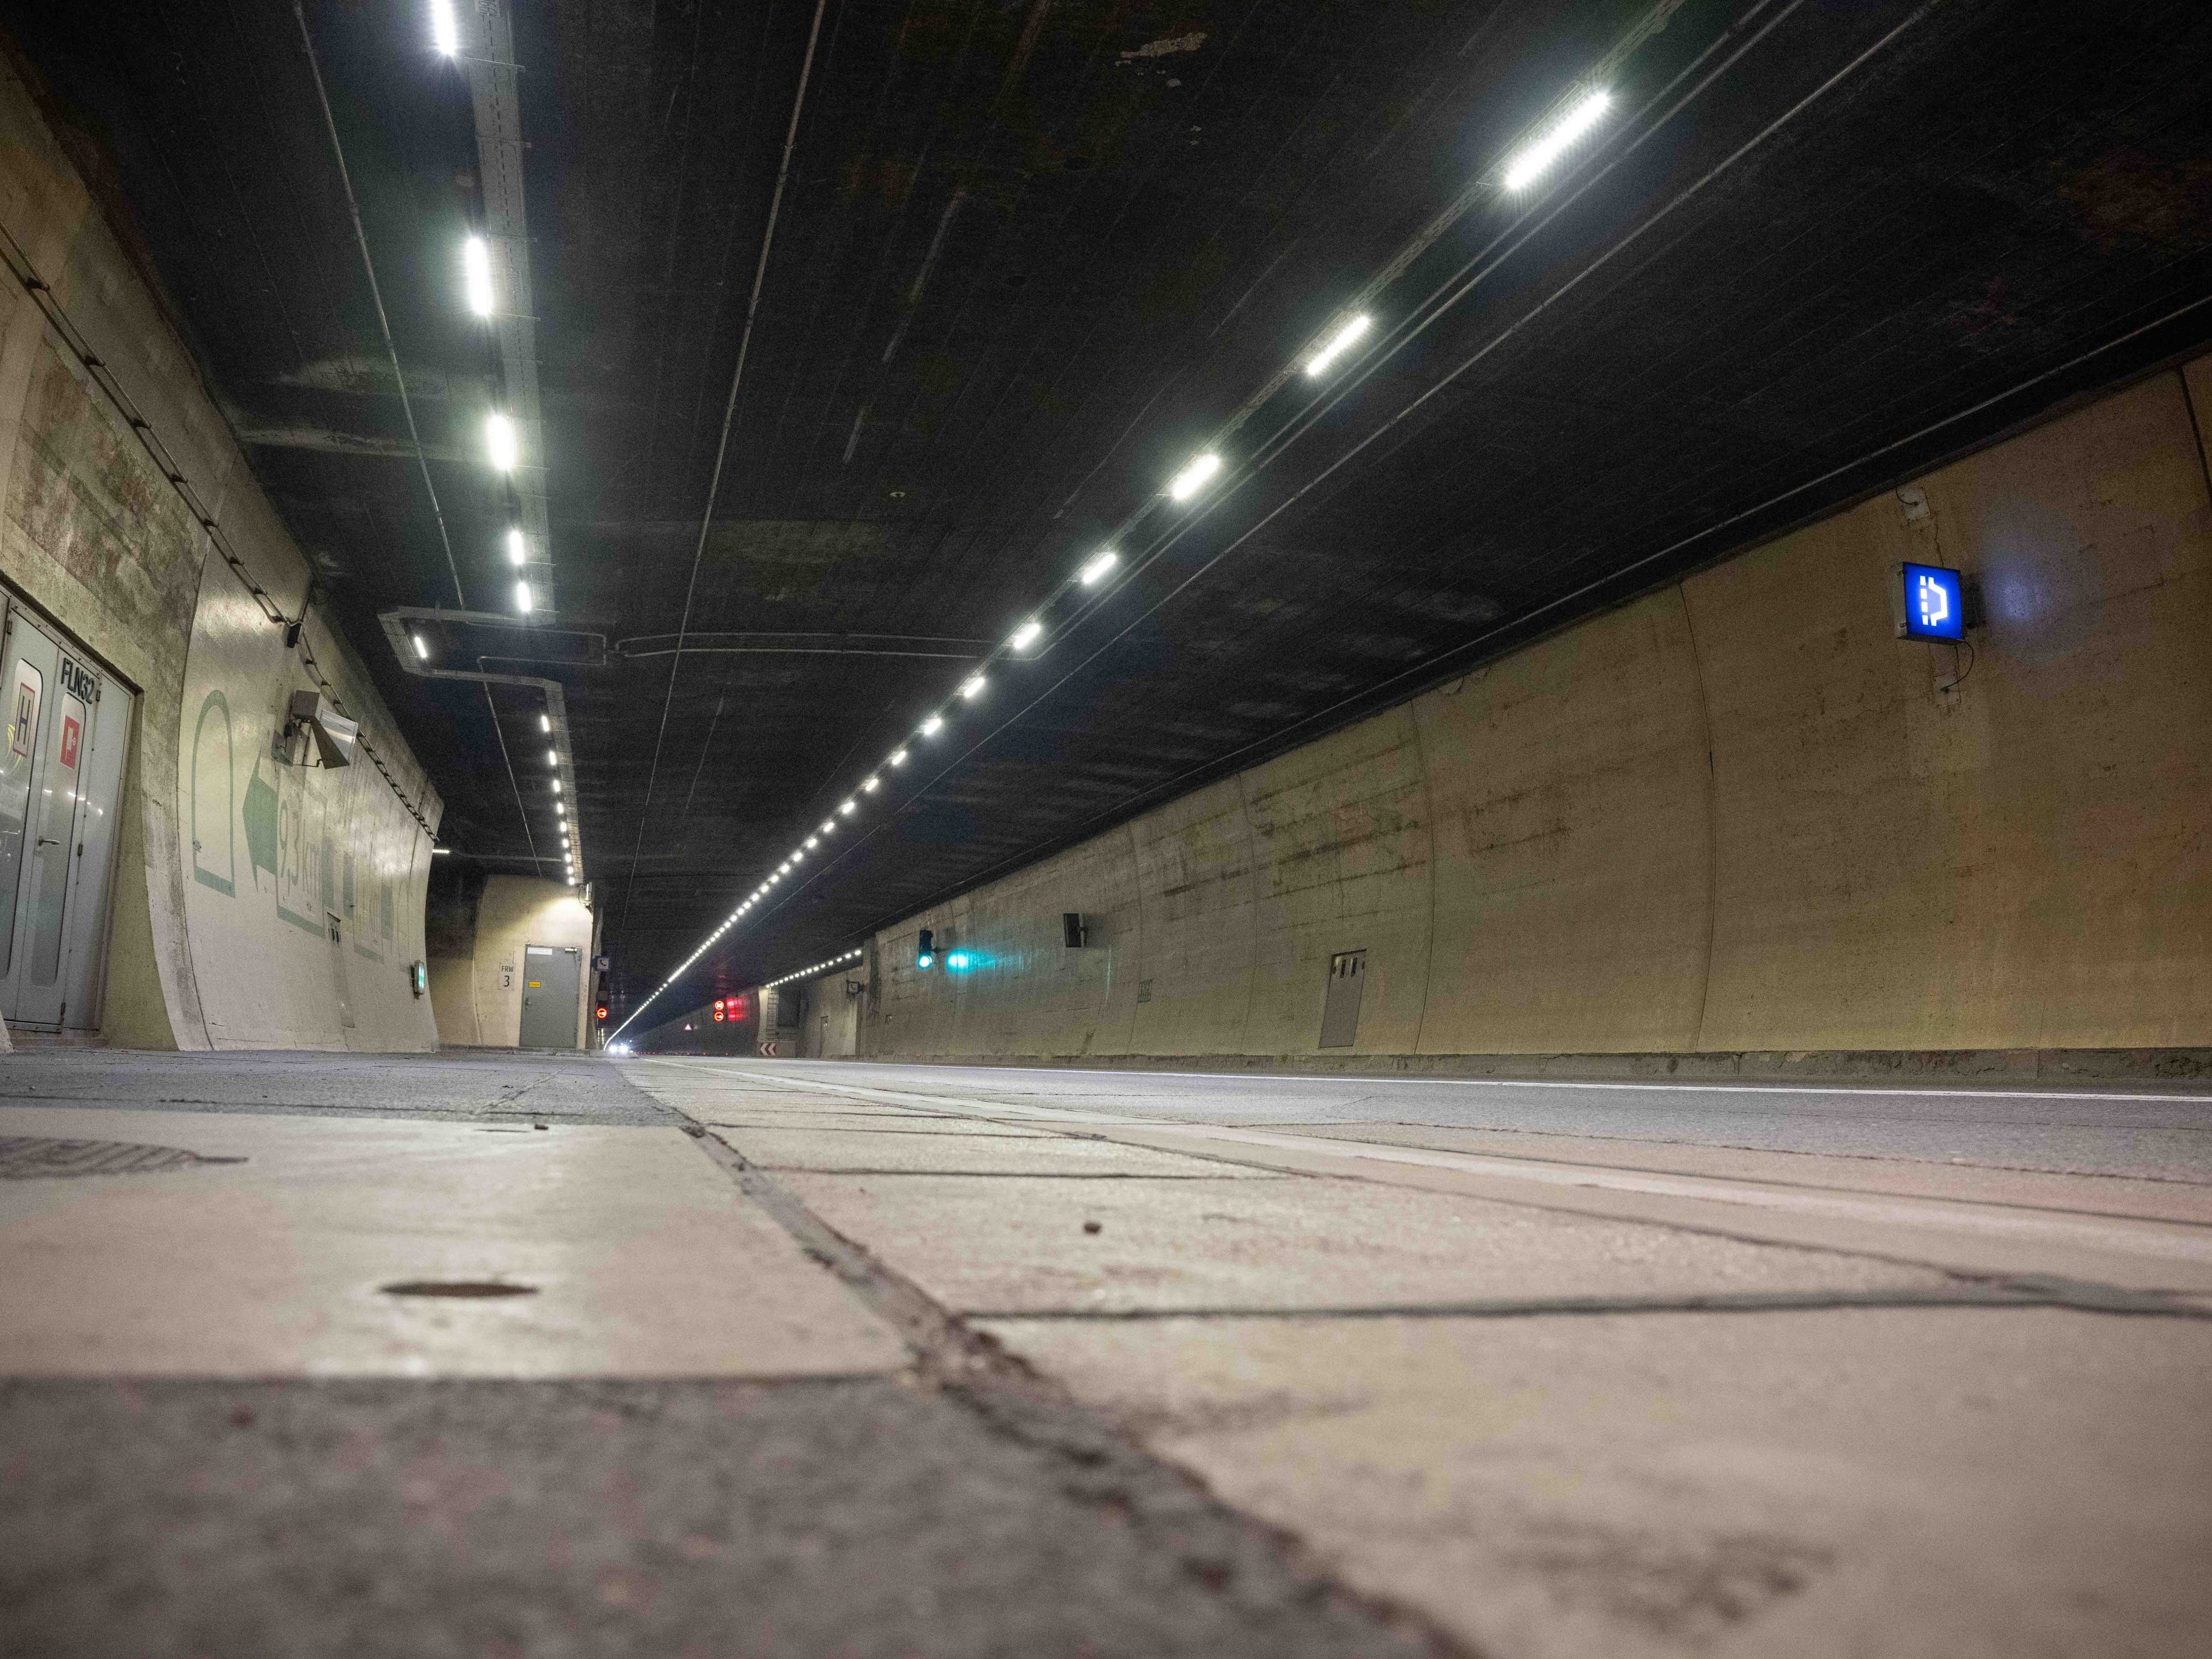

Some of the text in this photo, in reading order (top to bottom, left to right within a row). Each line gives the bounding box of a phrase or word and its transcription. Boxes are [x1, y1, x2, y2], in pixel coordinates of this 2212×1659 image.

[61, 657, 95, 704] FLN32
[17, 696, 31, 745] H
[503, 975, 510, 987] 3
